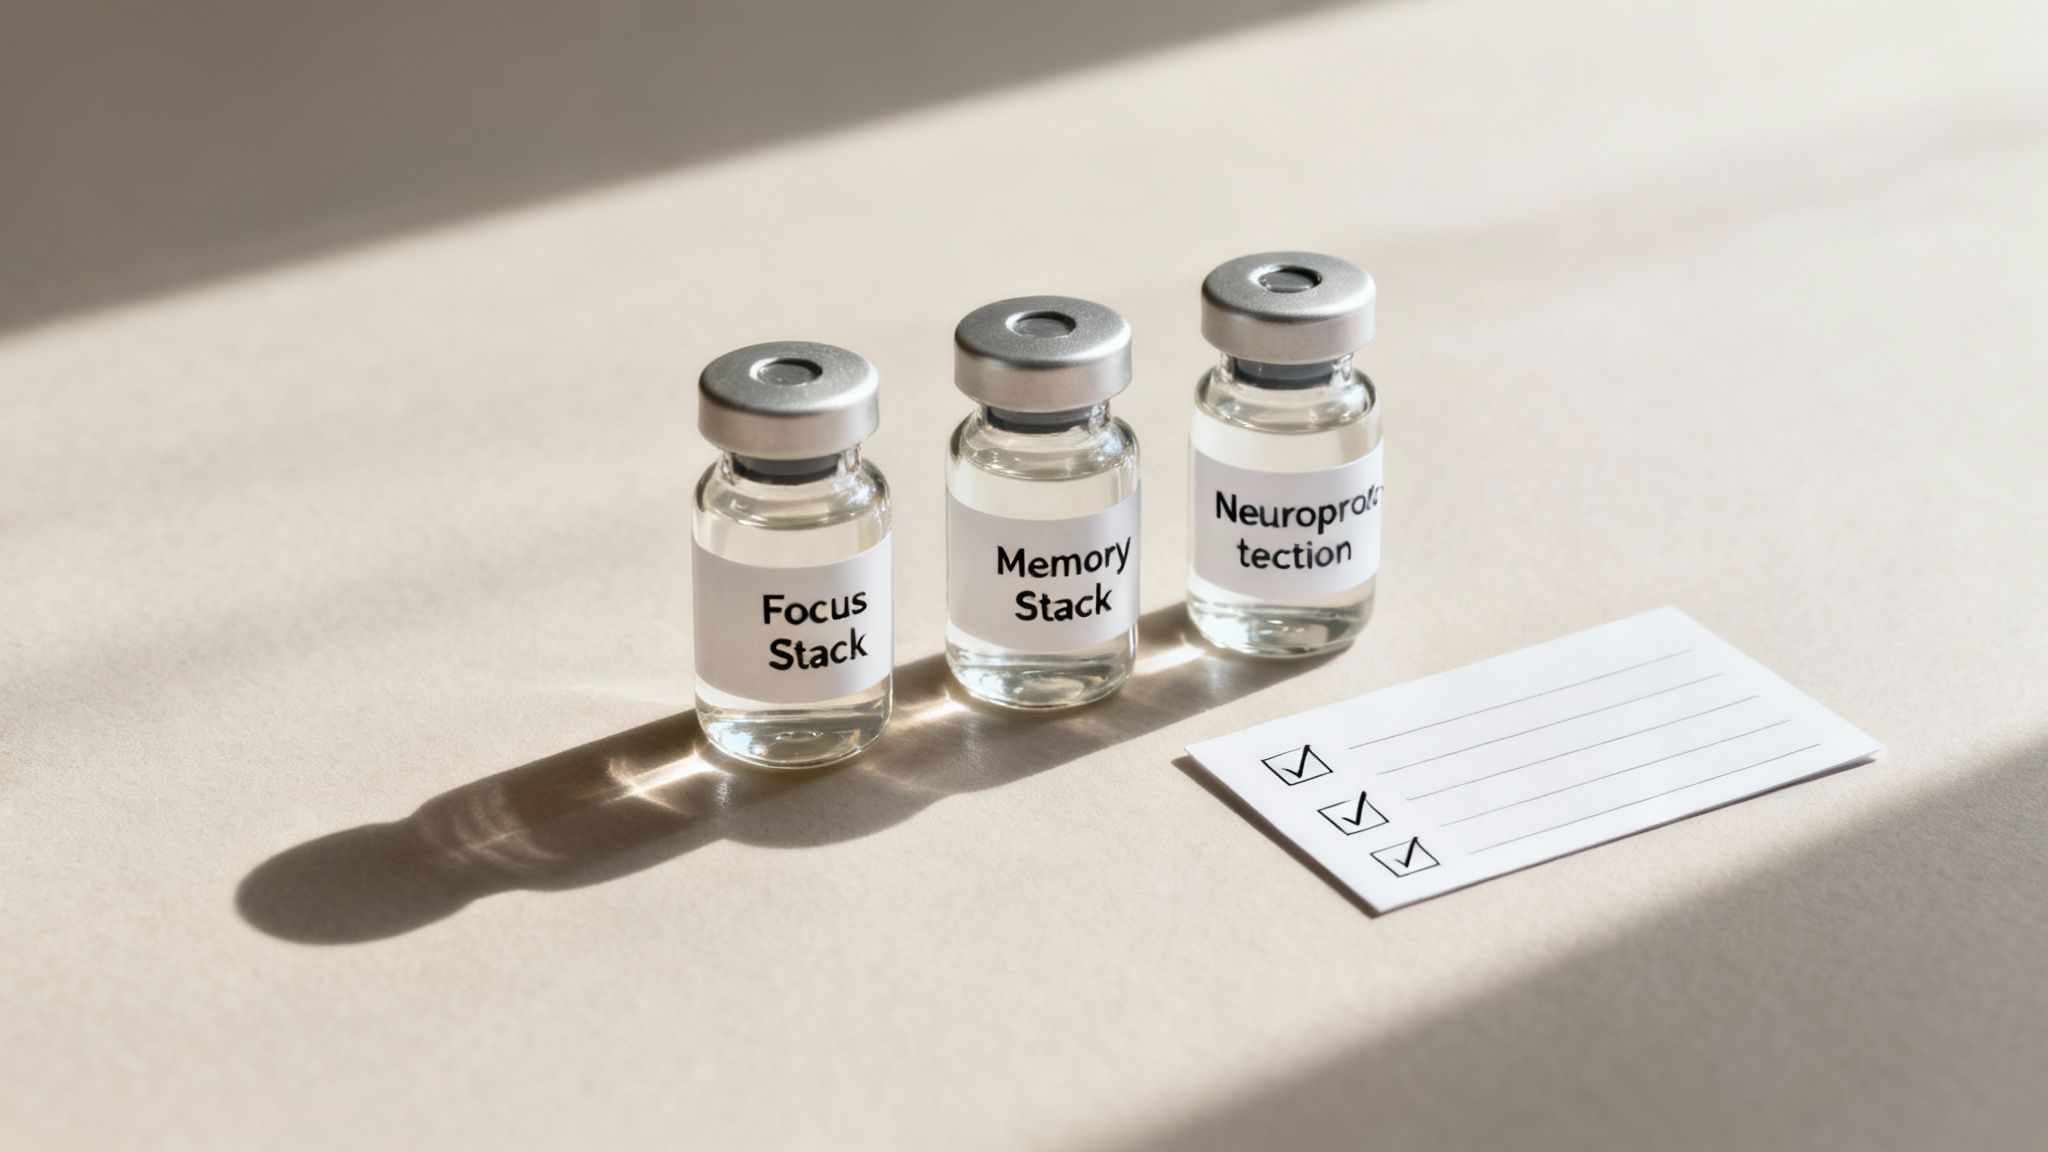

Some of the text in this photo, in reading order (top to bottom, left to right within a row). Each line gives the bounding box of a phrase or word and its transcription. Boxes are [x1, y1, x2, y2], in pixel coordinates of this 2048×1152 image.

[996, 536, 1132, 579] Memory
[1236, 537, 1353, 570] tection
[762, 590, 868, 626] Focus
[1014, 582, 1113, 622] Stack
[768, 627, 868, 671] Stack
